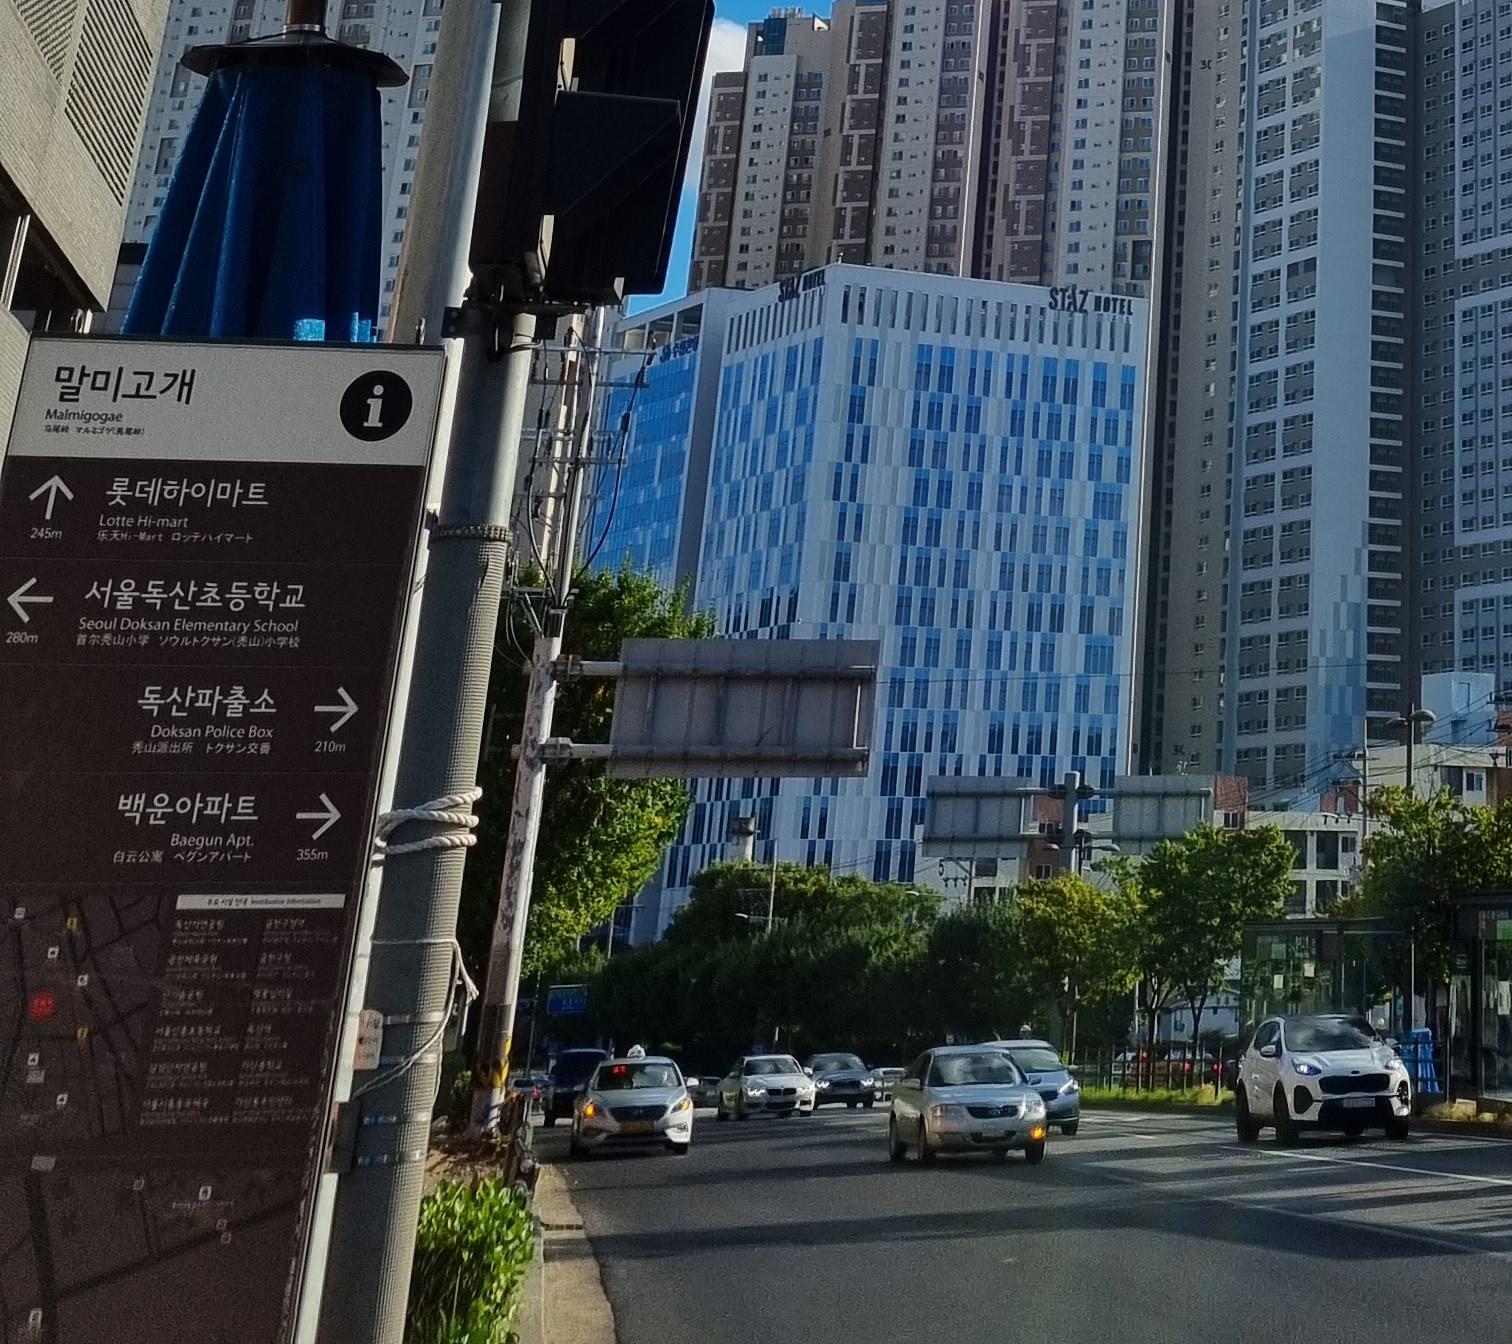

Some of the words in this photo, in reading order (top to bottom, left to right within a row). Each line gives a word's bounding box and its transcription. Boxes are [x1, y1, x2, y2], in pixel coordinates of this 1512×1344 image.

[1048, 284, 1089, 314] STAZ
[1094, 295, 1134, 316] HOTEL
[54, 363, 199, 405] 말미고개
[44, 408, 124, 424] Malmigogae
[105, 476, 270, 509] 롯데하이마트
[98, 514, 135, 528] Lotte
[137, 515, 190, 529] Hi-mart
[30, 527, 63, 541] 245m
[84, 577, 307, 613] 서울독산초등학교
[79, 616, 117, 631] Seoul
[120, 617, 170, 632] Doksan
[174, 618, 251, 634] Elementary
[254, 619, 299, 633] School
[137, 685, 278, 718] 독산파출소
[150, 724, 201, 738] Doksan
[204, 725, 246, 739] Police
[248, 725, 274, 739] Box
[314, 740, 347, 754] 210m
[117, 791, 259, 826] 백운아파트
[170, 832, 223, 850] Baegun
[226, 833, 255, 850] Apt.
[296, 848, 330, 862] 355m
